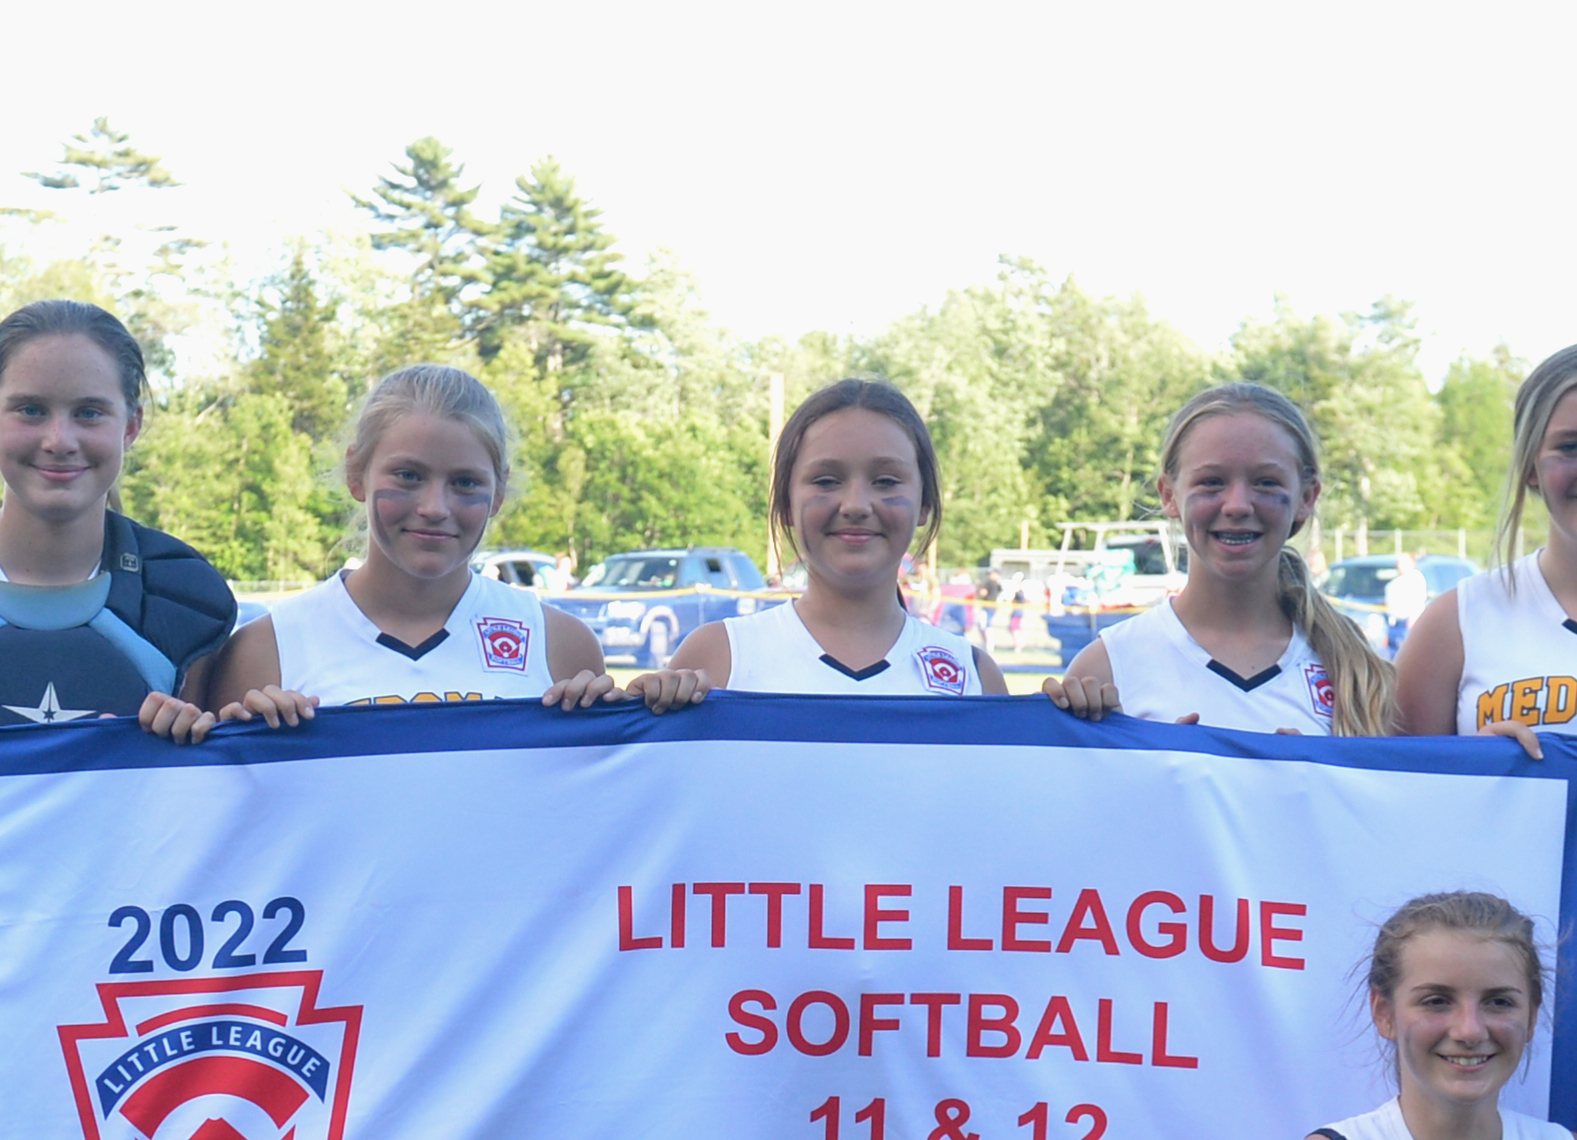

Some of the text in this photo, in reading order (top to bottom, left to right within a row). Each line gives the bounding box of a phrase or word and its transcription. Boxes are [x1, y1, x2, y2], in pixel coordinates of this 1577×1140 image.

[107, 896, 308, 974] 2022
[617, 882, 1308, 970] LITTLE LEAGUE
[103, 1025, 322, 1094] LITTLE LEAGUE
[725, 989, 1199, 1069] SOFTBALL
